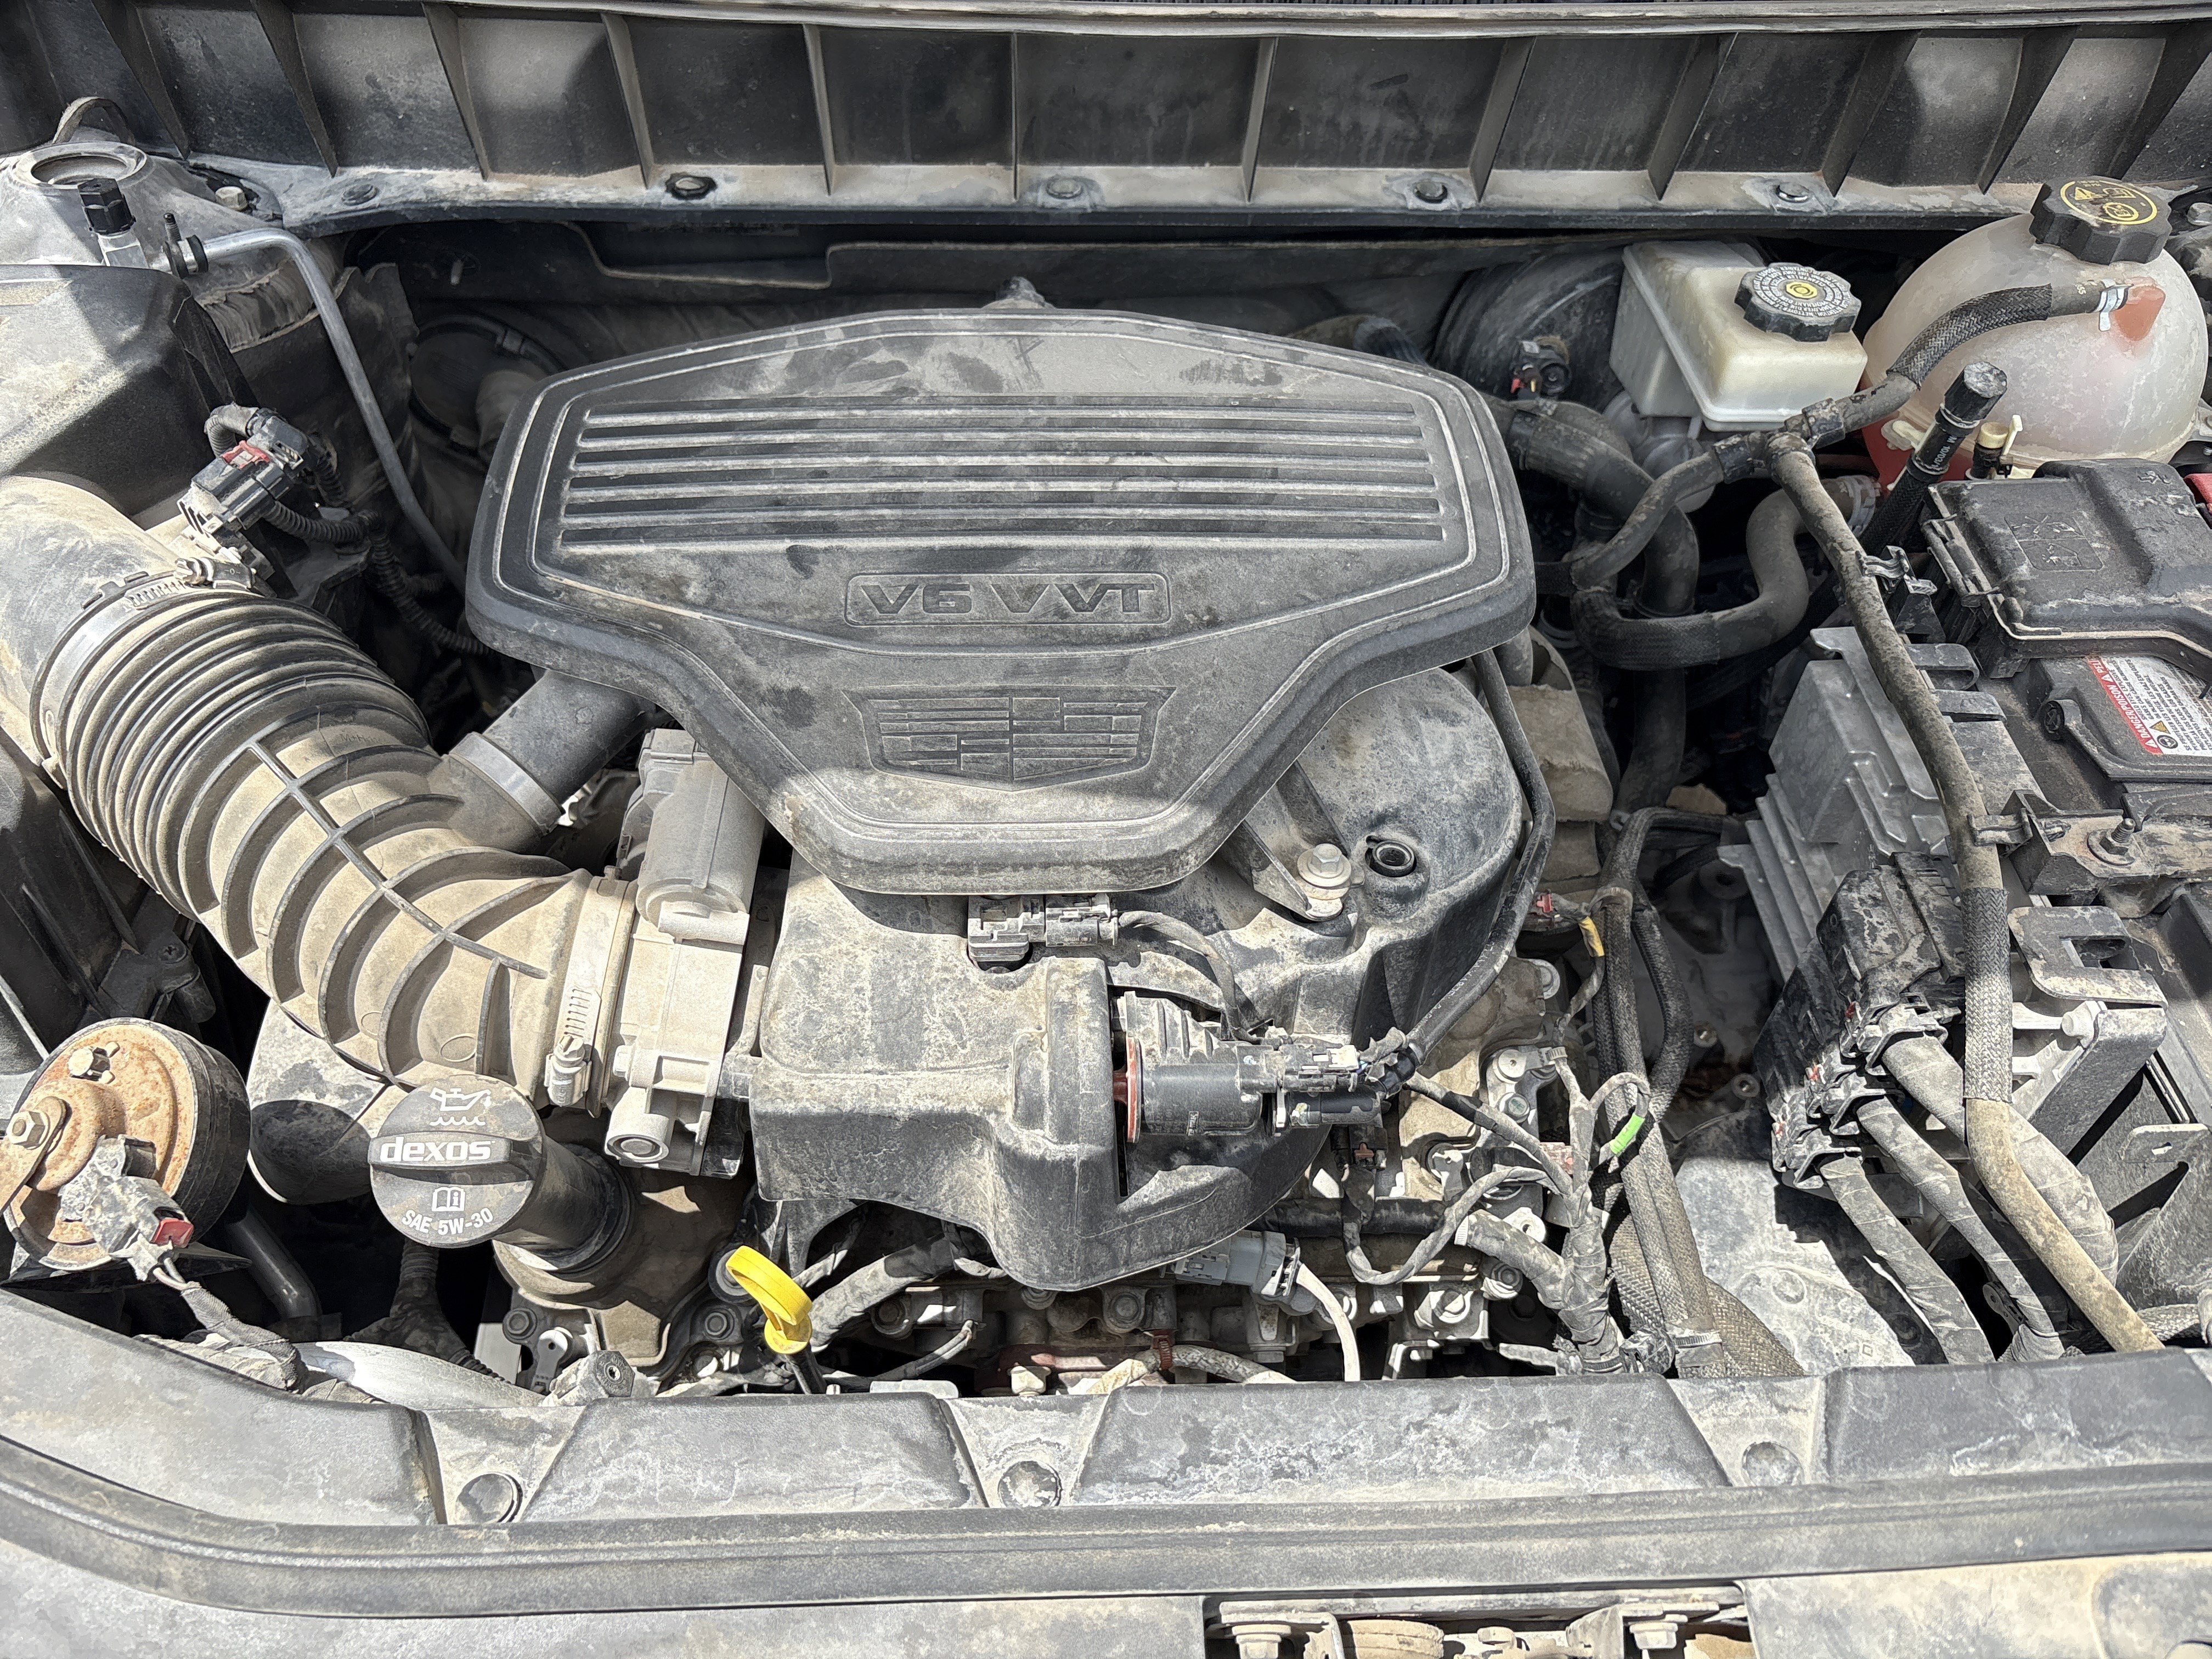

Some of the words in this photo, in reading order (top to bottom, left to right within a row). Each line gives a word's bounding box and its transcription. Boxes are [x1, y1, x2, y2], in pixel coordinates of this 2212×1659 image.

[861, 583, 972, 614] V6
[990, 583, 1155, 614] VVT
[2106, 685, 2151, 737] DANGER/POISON
[2140, 705, 2154, 719] GASES
[2182, 721, 2194, 730] LOS
[380, 1136, 491, 1162] dexos
[402, 1210, 432, 1233] SAE
[438, 1208, 493, 1235] 5W-30
